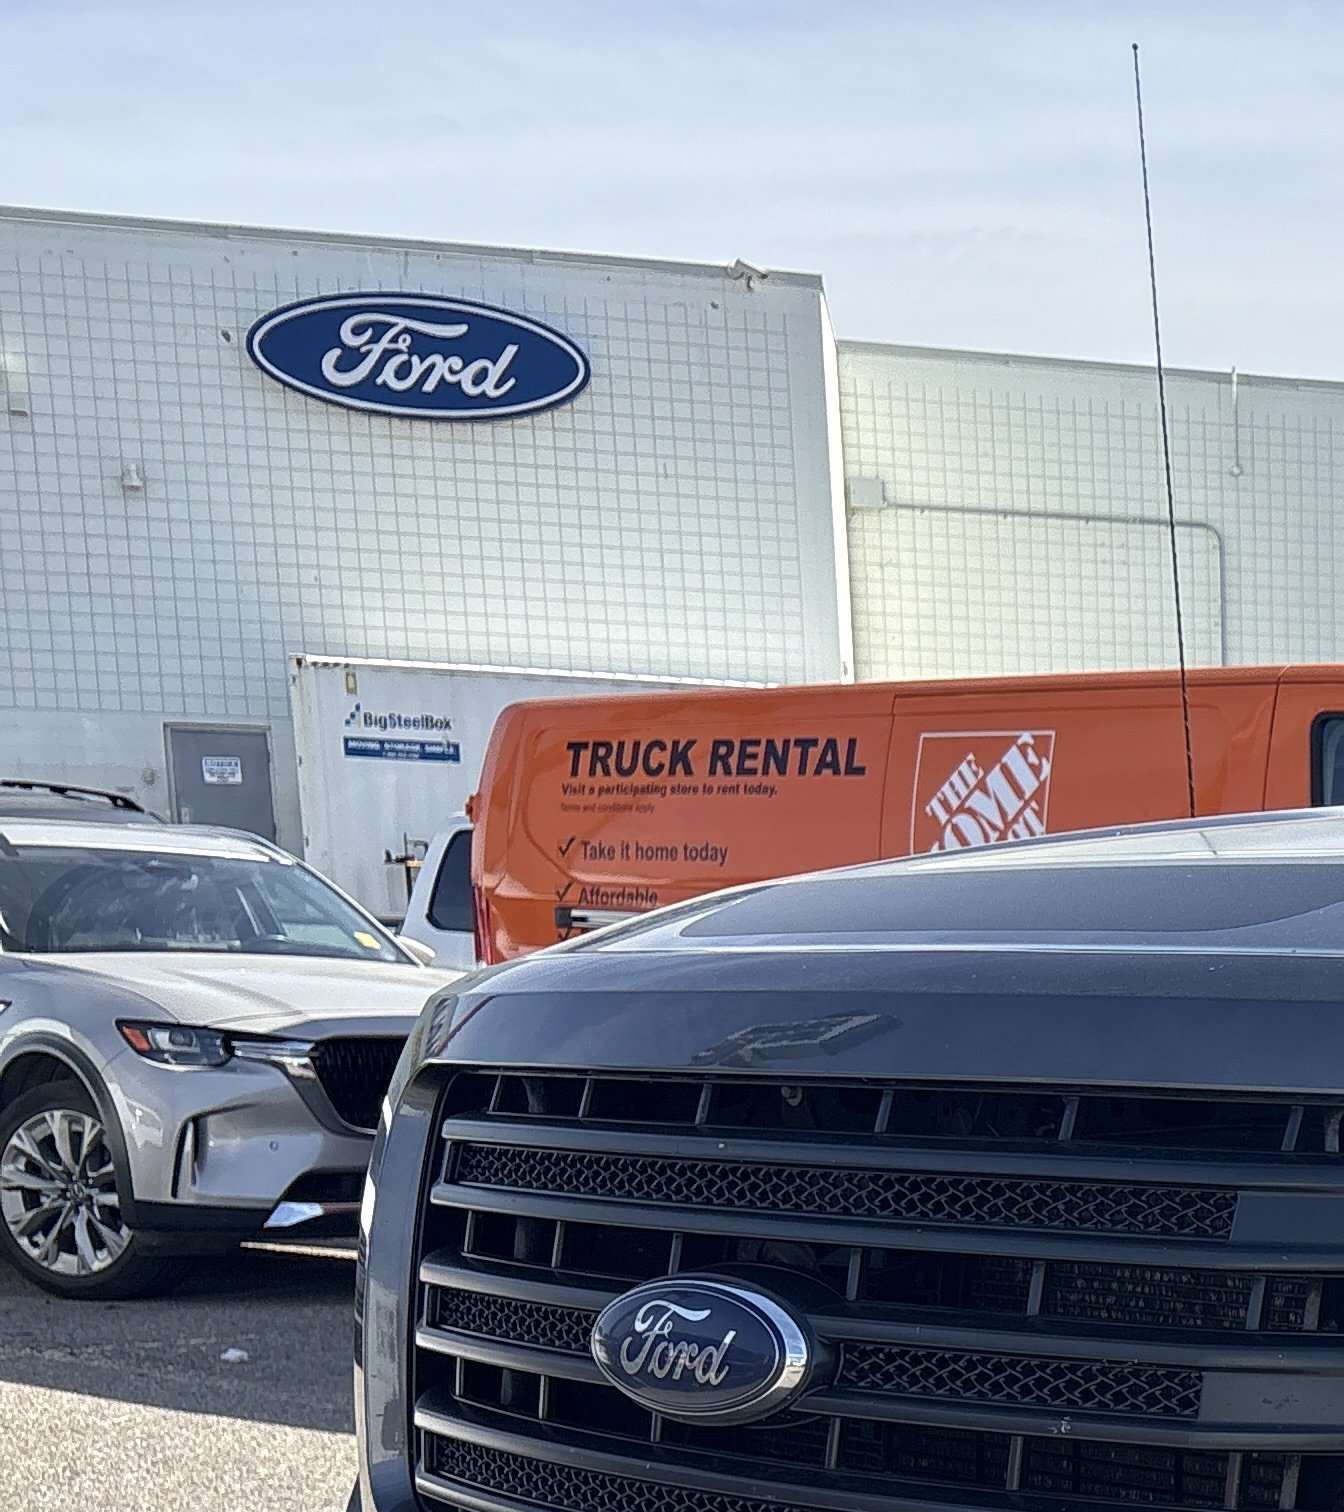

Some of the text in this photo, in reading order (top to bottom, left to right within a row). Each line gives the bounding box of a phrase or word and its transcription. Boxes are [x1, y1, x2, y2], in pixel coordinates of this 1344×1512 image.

[321, 312, 520, 399] Ford
[363, 711, 453, 731] BigSteelBox
[566, 737, 867, 777] TRUCK RENTAL
[561, 781, 778, 798] Visit a participating store to rent today.
[925, 752, 985, 828] THE
[930, 732, 1051, 853] OME
[580, 840, 729, 867] Take it home today
[578, 886, 658, 905] Affordable
[619, 1299, 738, 1387] Ford
